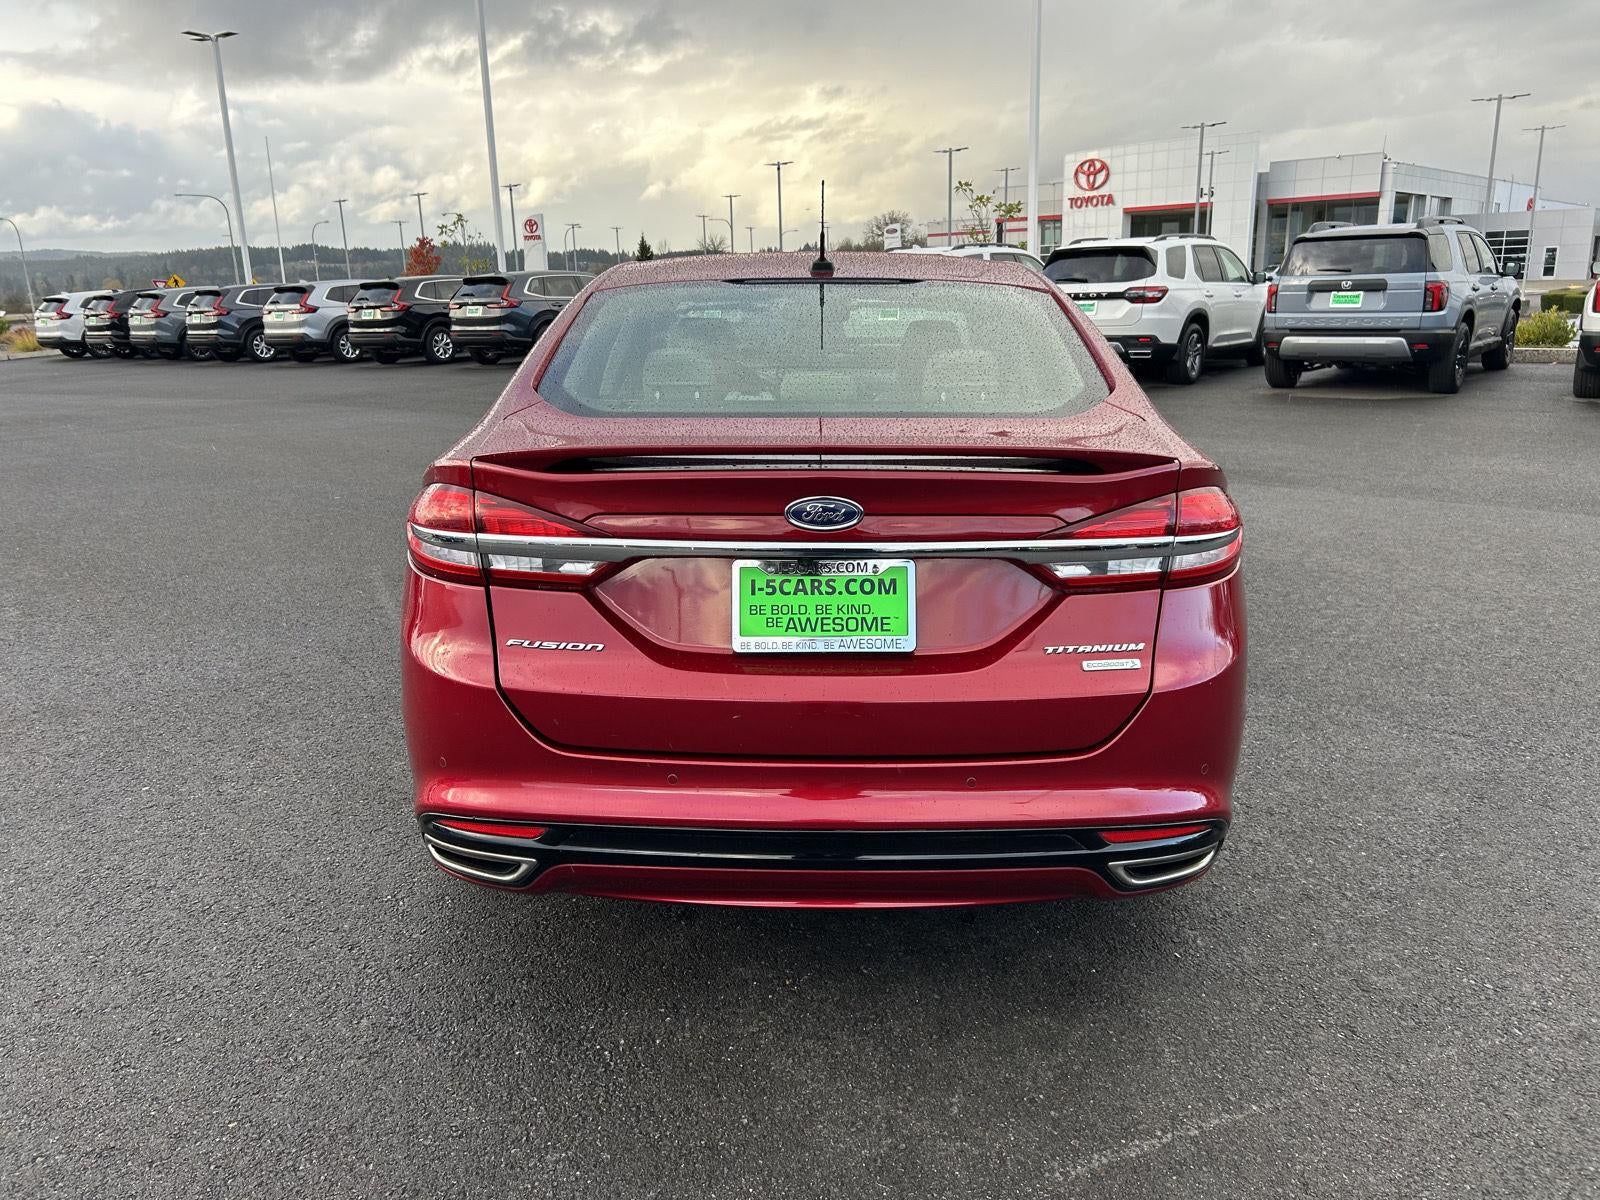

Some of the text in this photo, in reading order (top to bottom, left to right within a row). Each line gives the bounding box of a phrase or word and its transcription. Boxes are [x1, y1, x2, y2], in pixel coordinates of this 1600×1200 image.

[1068, 194, 1116, 209] TOYOTA
[1284, 318, 1409, 327] PASSPORT
[802, 503, 846, 521] Ford
[750, 578, 898, 596] I-5CARS.COM
[749, 603, 875, 616] BE BOLD. BE KIND.
[766, 617, 783, 628] BE
[505, 639, 605, 652] FUSION
[740, 641, 752, 650] BE
[754, 641, 781, 650] BOLD.
[781, 641, 794, 650] BE
[795, 641, 820, 650] KIND.
[823, 641, 835, 650] BE
[1044, 642, 1146, 655] TITANIUM
[1086, 661, 1130, 669] ECOBOOST
